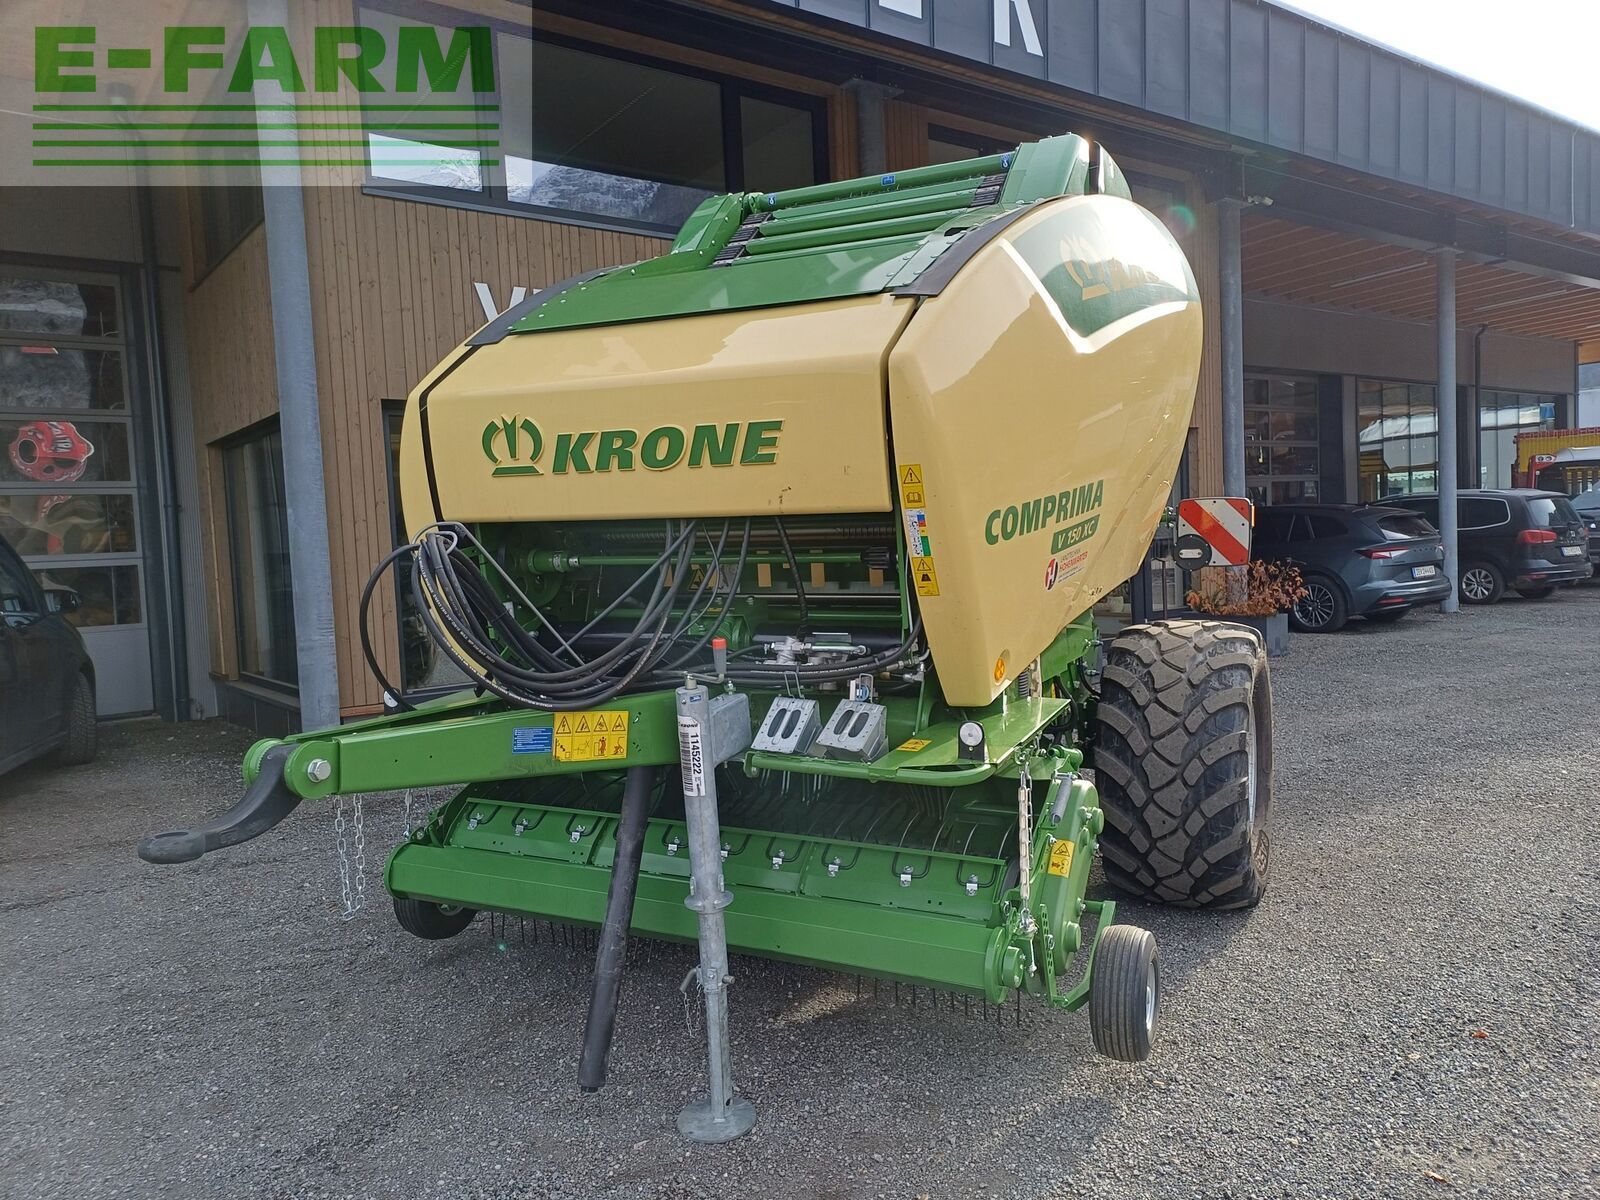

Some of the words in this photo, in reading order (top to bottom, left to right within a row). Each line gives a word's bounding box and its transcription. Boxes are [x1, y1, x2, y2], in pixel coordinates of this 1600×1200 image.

[552, 419, 785, 474] KRONE
[985, 479, 1104, 545] COMPRIMA
[1058, 533, 1066, 548] V
[1067, 526, 1081, 545] 150
[1081, 520, 1095, 538] XC
[690, 733, 702, 775] 1145222
